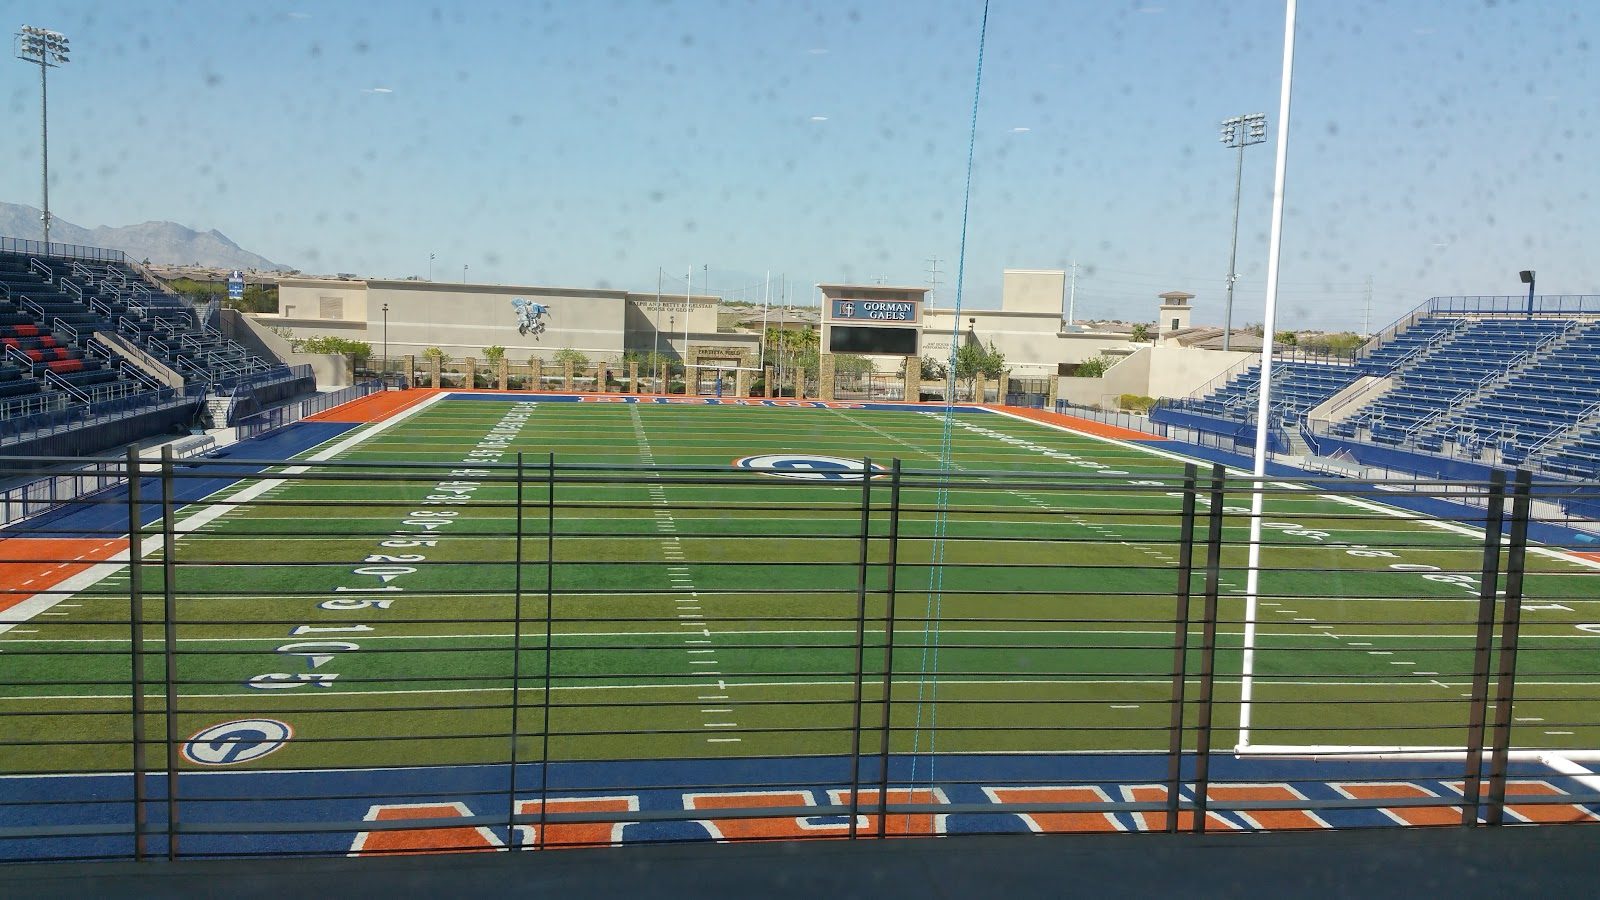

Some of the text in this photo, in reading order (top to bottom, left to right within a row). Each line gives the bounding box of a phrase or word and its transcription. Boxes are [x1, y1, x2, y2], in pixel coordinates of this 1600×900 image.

[863, 302, 912, 312] GORMAN
[869, 311, 906, 320] GAELS
[318, 585, 404, 611] 15
[275, 624, 376, 657] 10
